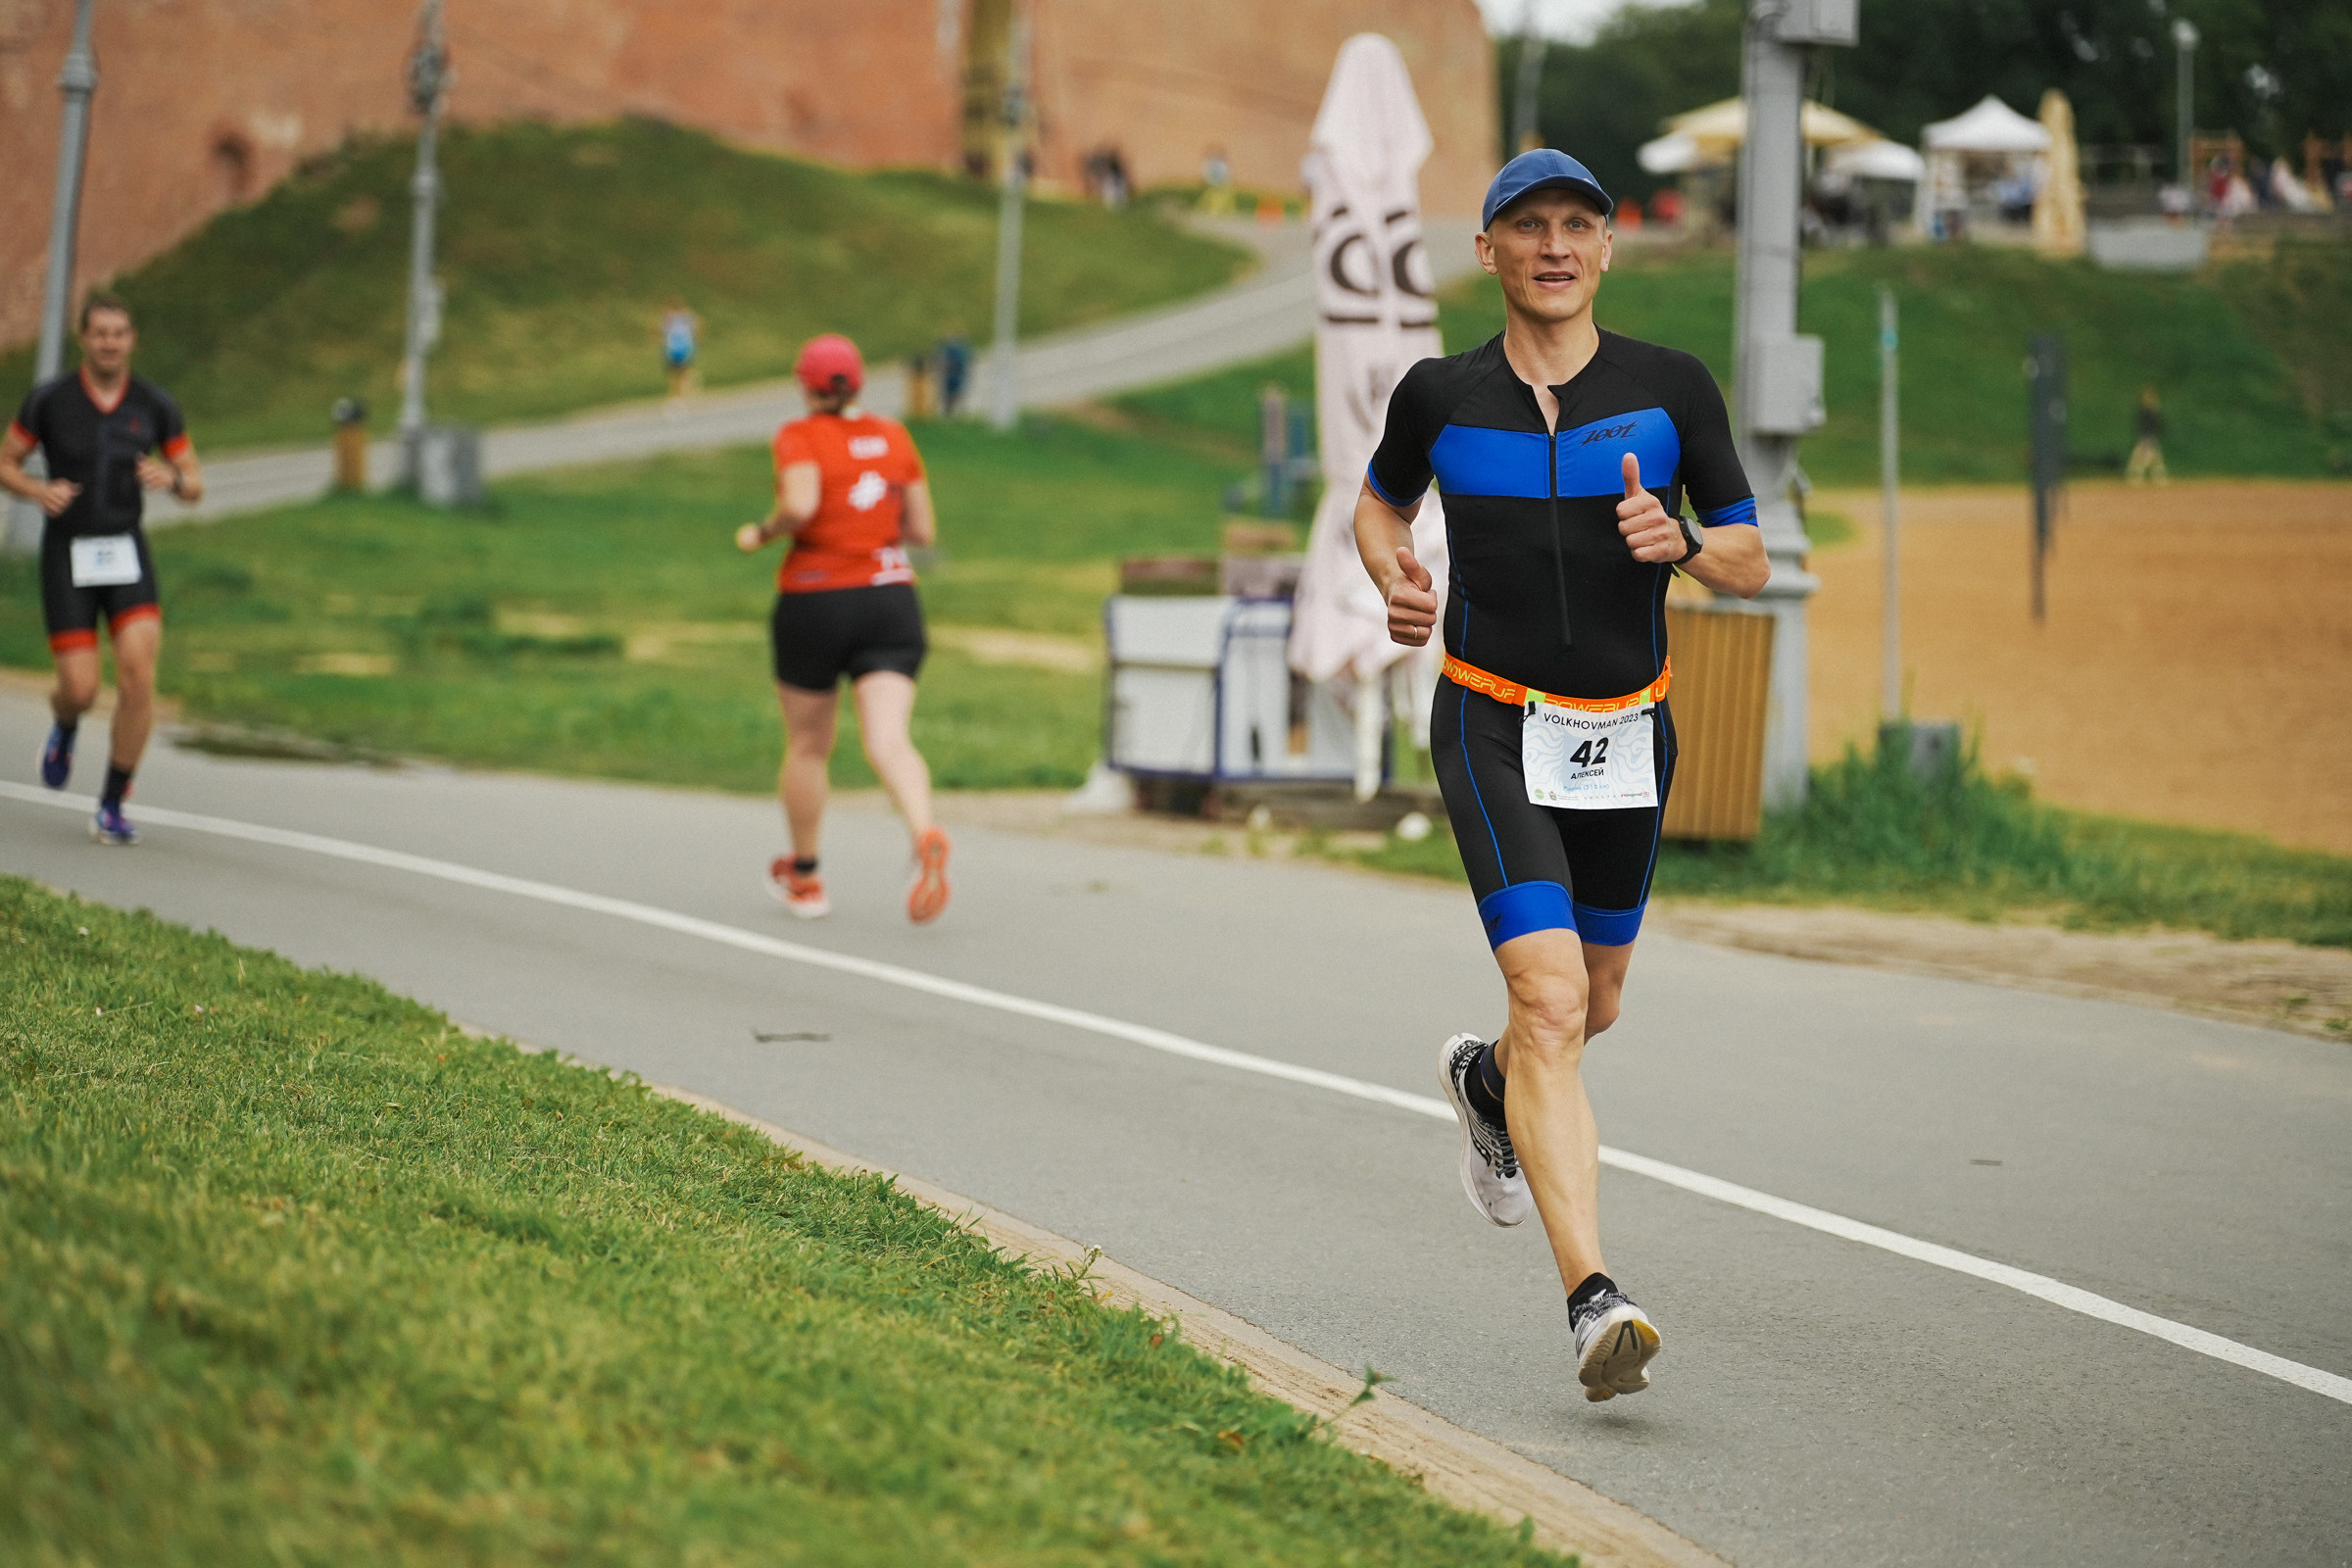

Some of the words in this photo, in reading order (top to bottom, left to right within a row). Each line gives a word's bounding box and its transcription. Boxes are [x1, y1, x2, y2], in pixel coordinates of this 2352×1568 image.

[1544, 712, 1618, 730] VOLKHOVMAN
[1619, 712, 1639, 725] 2023
[1570, 737, 1609, 768] 42
[1570, 767, 1604, 780] АЛЕКСЕЙ
